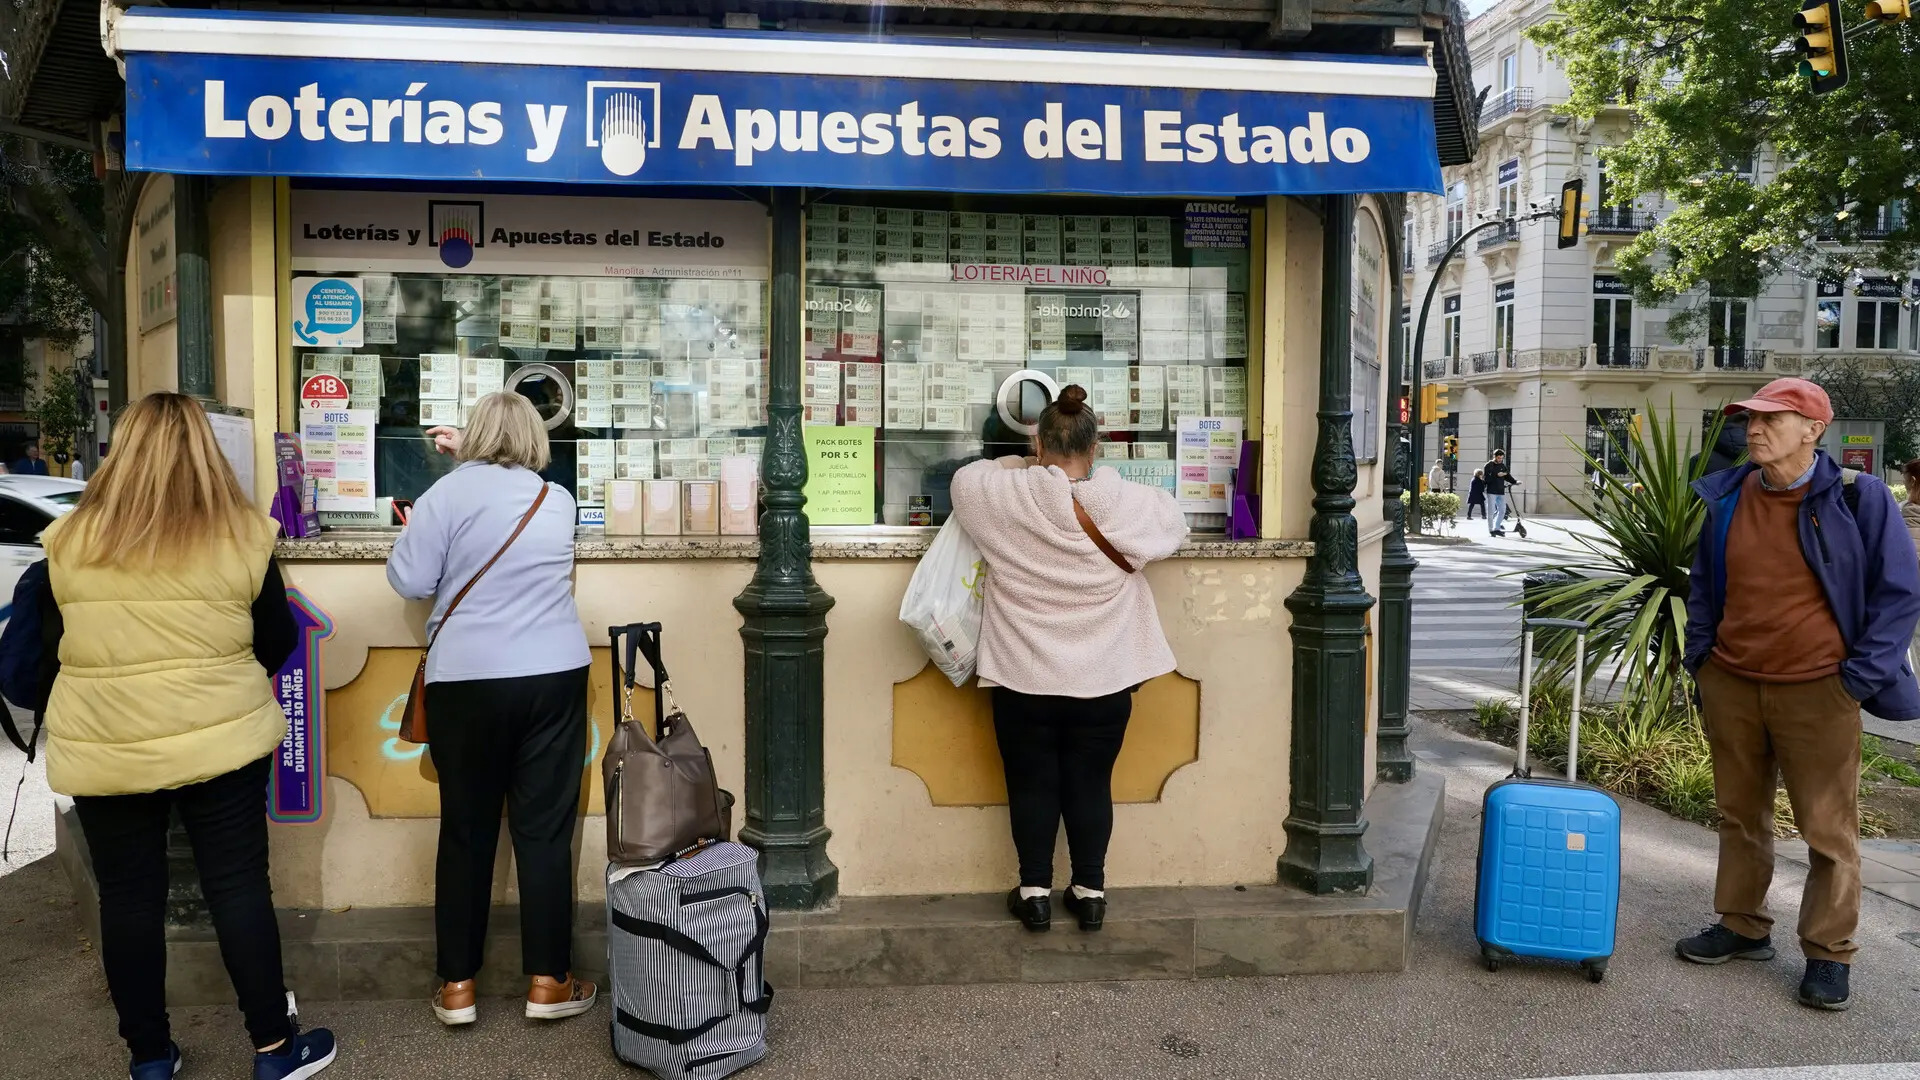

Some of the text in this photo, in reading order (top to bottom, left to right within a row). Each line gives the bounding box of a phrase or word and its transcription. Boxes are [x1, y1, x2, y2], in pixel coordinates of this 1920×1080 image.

[204, 80, 1371, 168] Loterías y Apuestas del Estado
[303, 223, 725, 248] Loterías y Apuestas del Estado
[604, 265, 645, 276] Manolita
[651, 266, 720, 277] Administración
[1062, 266, 1107, 285] NIÑO
[311, 378, 338, 394] +18
[324, 412, 349, 423] BOTES
[1199, 420, 1221, 430] BOTES
[821, 451, 841, 459] POR
[851, 451, 858, 459] €
[583, 511, 604, 519] VISA
[282, 674, 292, 699] MES
[291, 668, 304, 700] AÑOS
[283, 700, 292, 716] AL
[294, 701, 304, 717] 30
[294, 718, 305, 773] DURANTE
